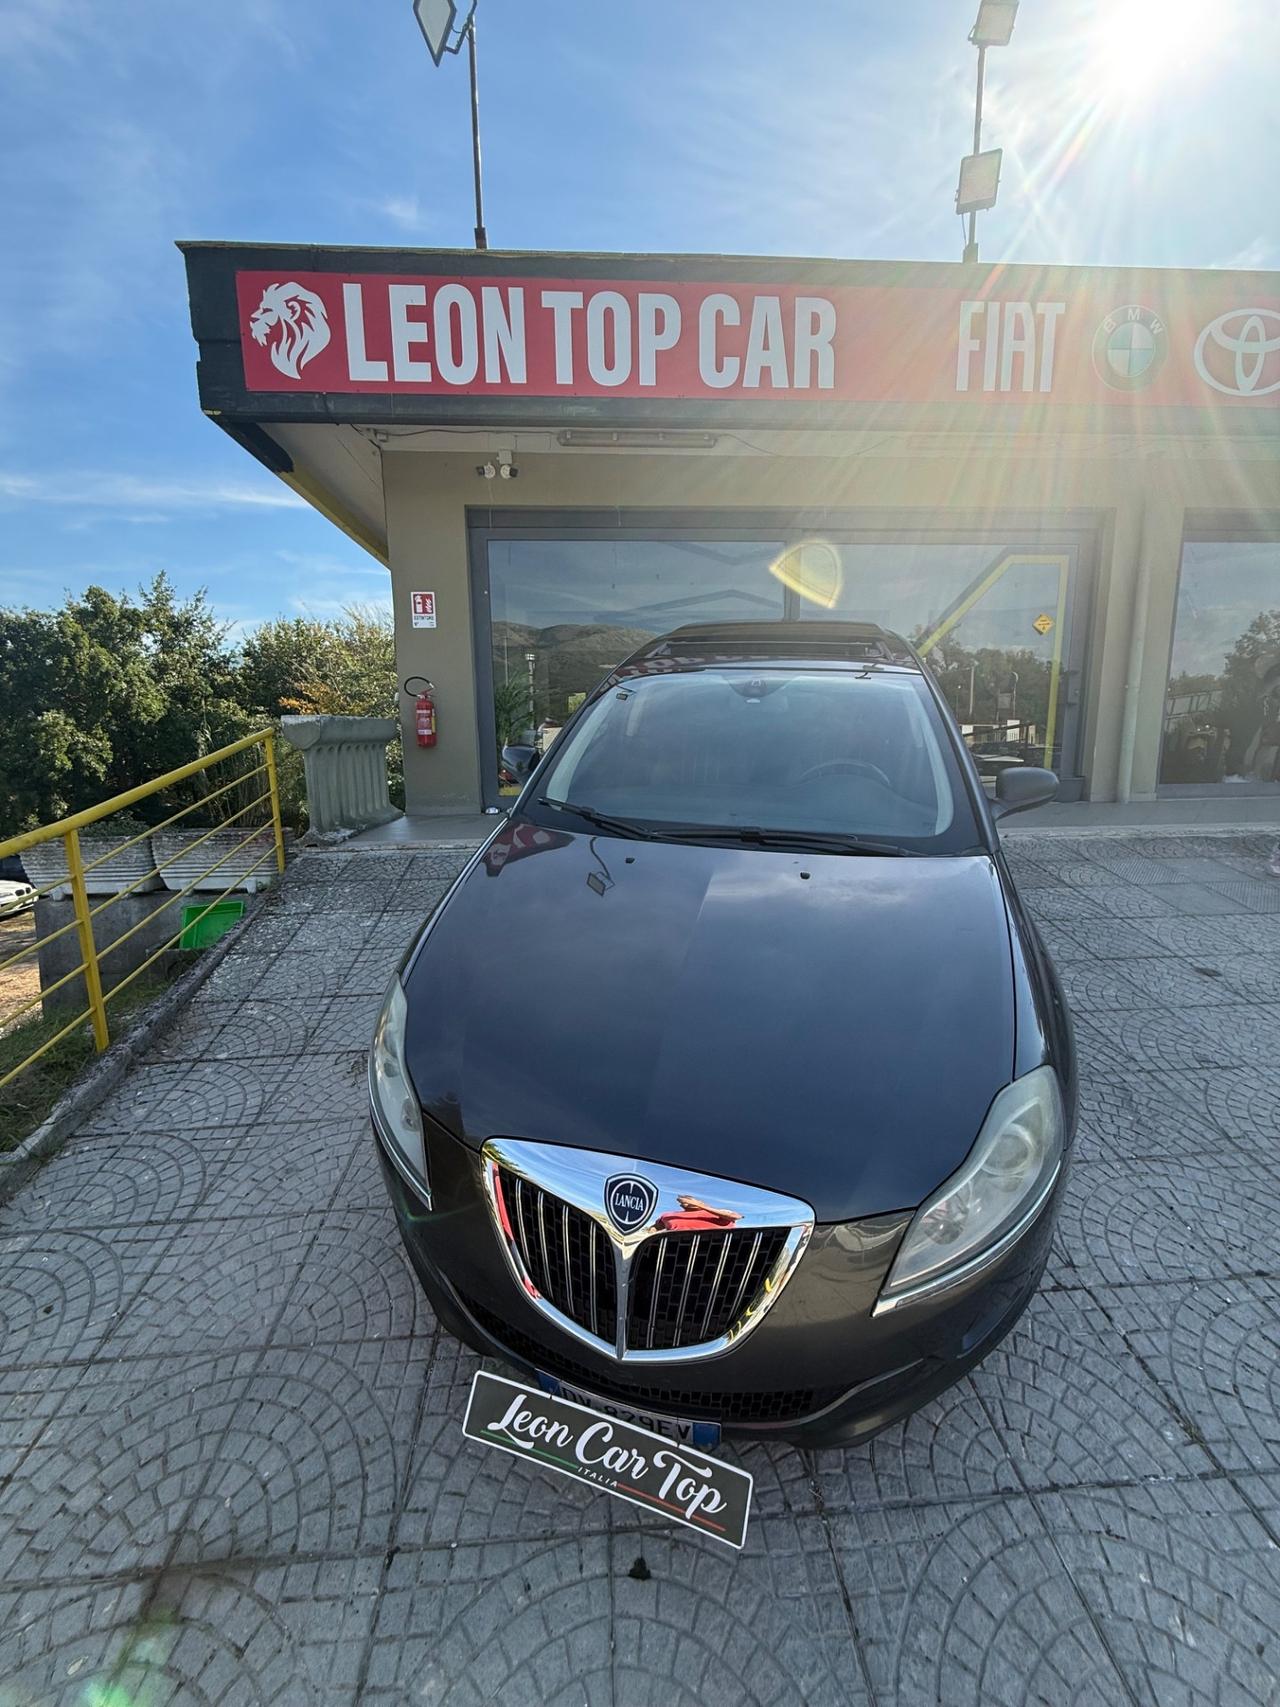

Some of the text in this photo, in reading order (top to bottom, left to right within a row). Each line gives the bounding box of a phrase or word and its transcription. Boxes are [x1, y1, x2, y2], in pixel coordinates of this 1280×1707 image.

[342, 283, 837, 389] LEON TOP CAR
[956, 301, 1066, 392] FIAT
[1103, 308, 1164, 335] BMW
[614, 1193, 644, 1211] LANCIA
